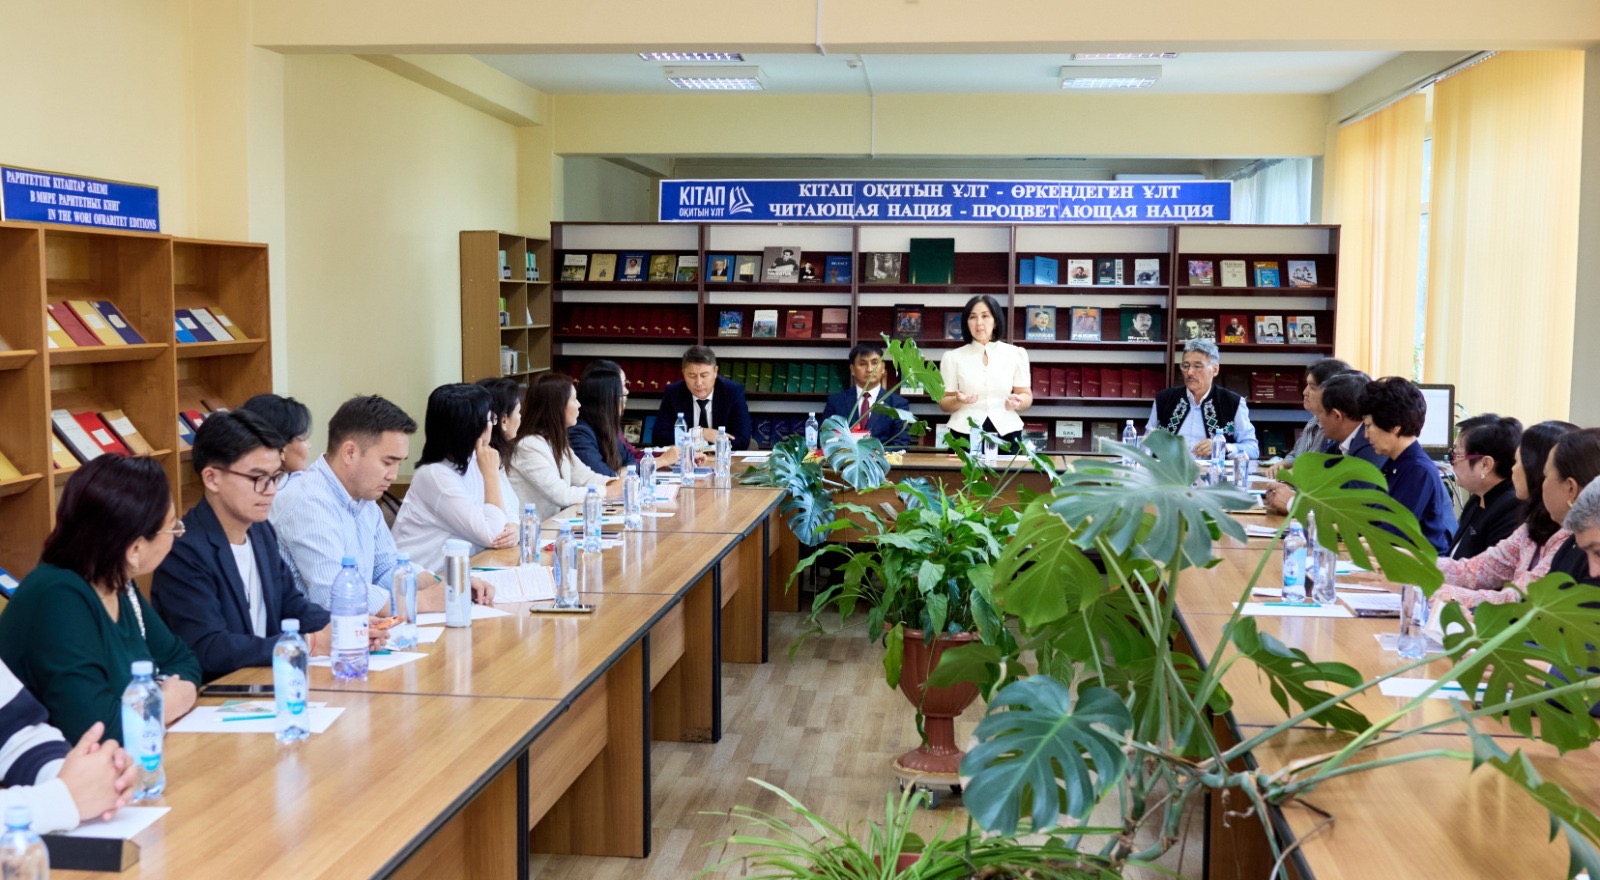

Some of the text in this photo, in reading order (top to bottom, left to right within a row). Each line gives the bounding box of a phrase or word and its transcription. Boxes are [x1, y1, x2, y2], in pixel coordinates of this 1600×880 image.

[6, 170, 108, 196] РАРИТЕТТІК КІТАПТАР ӘЛЕМІ
[799, 183, 853, 197] КІТАП
[863, 183, 944, 200] ОҚИТЫН
[952, 184, 989, 197] ҰЛТ
[1011, 184, 1134, 201] ӨРКЕНДЕГЕН
[1143, 185, 1181, 199] ҰЛТ
[30, 190, 120, 212] В МИРЕ РАРИТЕТНЫХ КНИГ
[679, 186, 726, 206] КІТАП
[48, 208, 56, 220] IN
[58, 209, 72, 222] THE
[129, 217, 157, 230] EDITIONS
[679, 207, 709, 218] ОҚИТЫН
[769, 203, 880, 219] ЧИТАЮЩАЯ
[888, 203, 952, 220] НАЦИЯ
[972, 204, 1138, 220] ПРОЦВЕТАЮЩАЯ
[1146, 204, 1214, 220] НАЦИЯ
